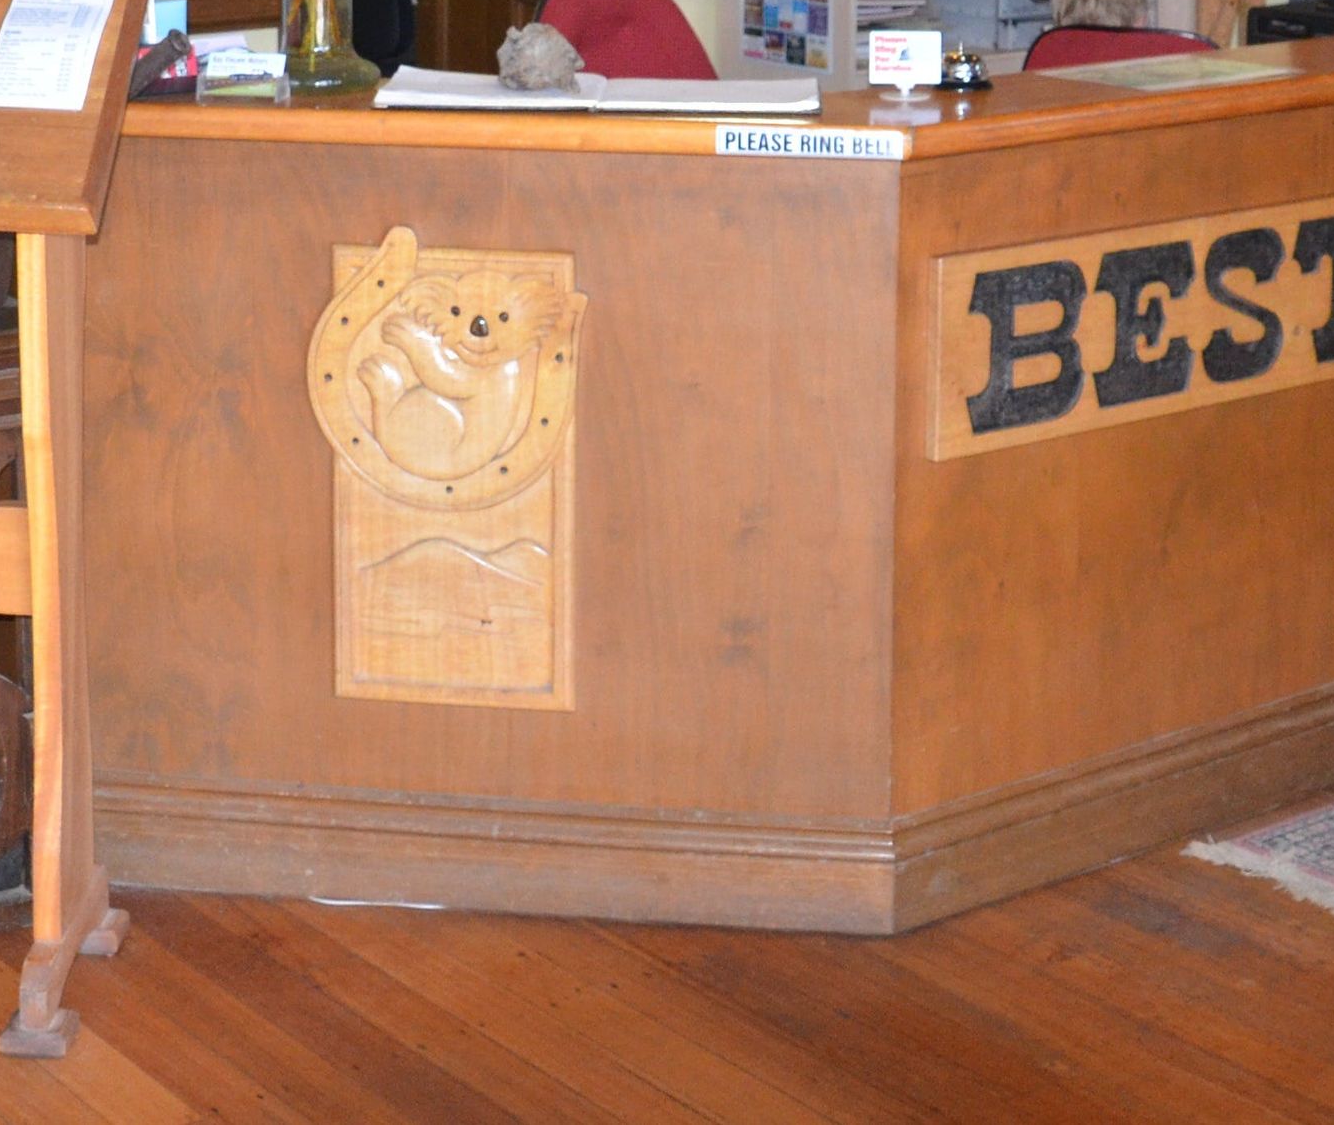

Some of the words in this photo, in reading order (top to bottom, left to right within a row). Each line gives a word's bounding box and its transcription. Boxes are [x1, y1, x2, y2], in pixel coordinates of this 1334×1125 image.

[725, 131, 793, 153] PLEASE
[800, 134, 844, 154] RING
[853, 136, 893, 156] BELL
